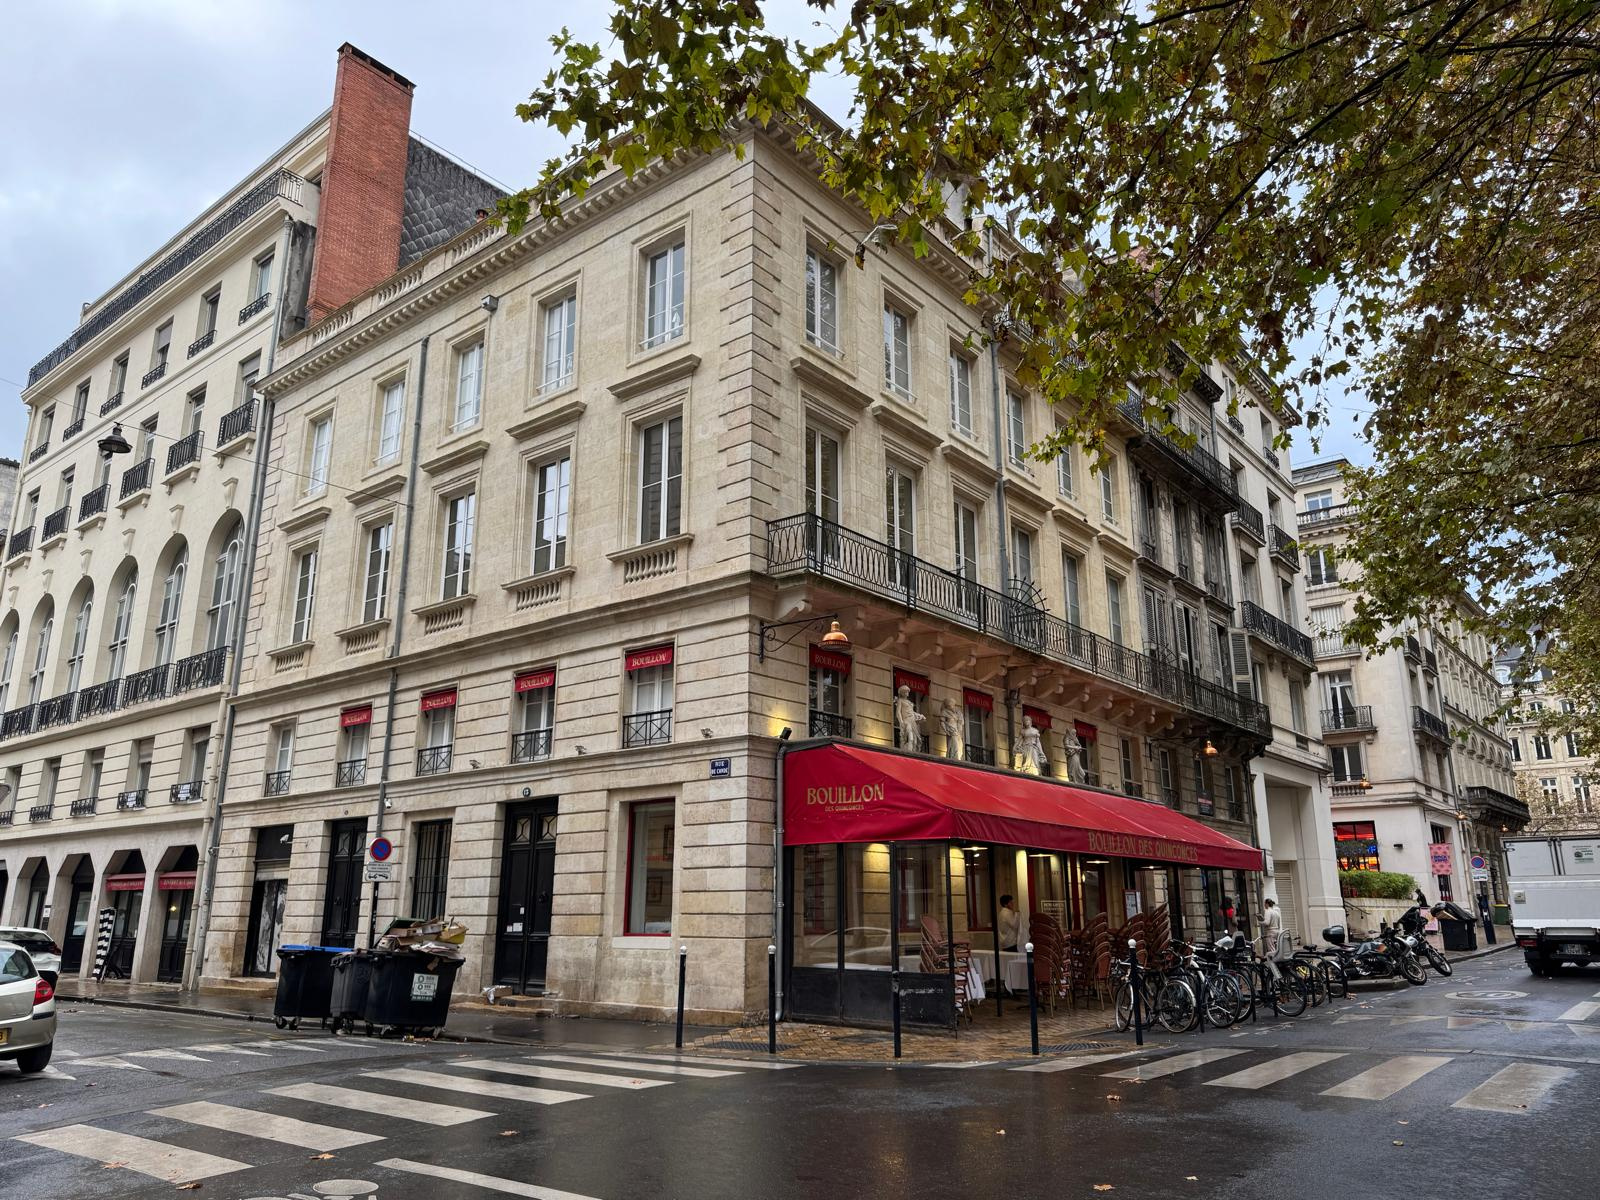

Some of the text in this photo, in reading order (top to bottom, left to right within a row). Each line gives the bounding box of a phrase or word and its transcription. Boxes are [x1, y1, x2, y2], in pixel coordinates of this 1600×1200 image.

[632, 653, 667, 667] BOUILLON
[815, 655, 846, 670] BOUILLON
[807, 783, 885, 805] BOUILLON
[1088, 831, 1198, 861] BOUILLON DES QUINCONCES
